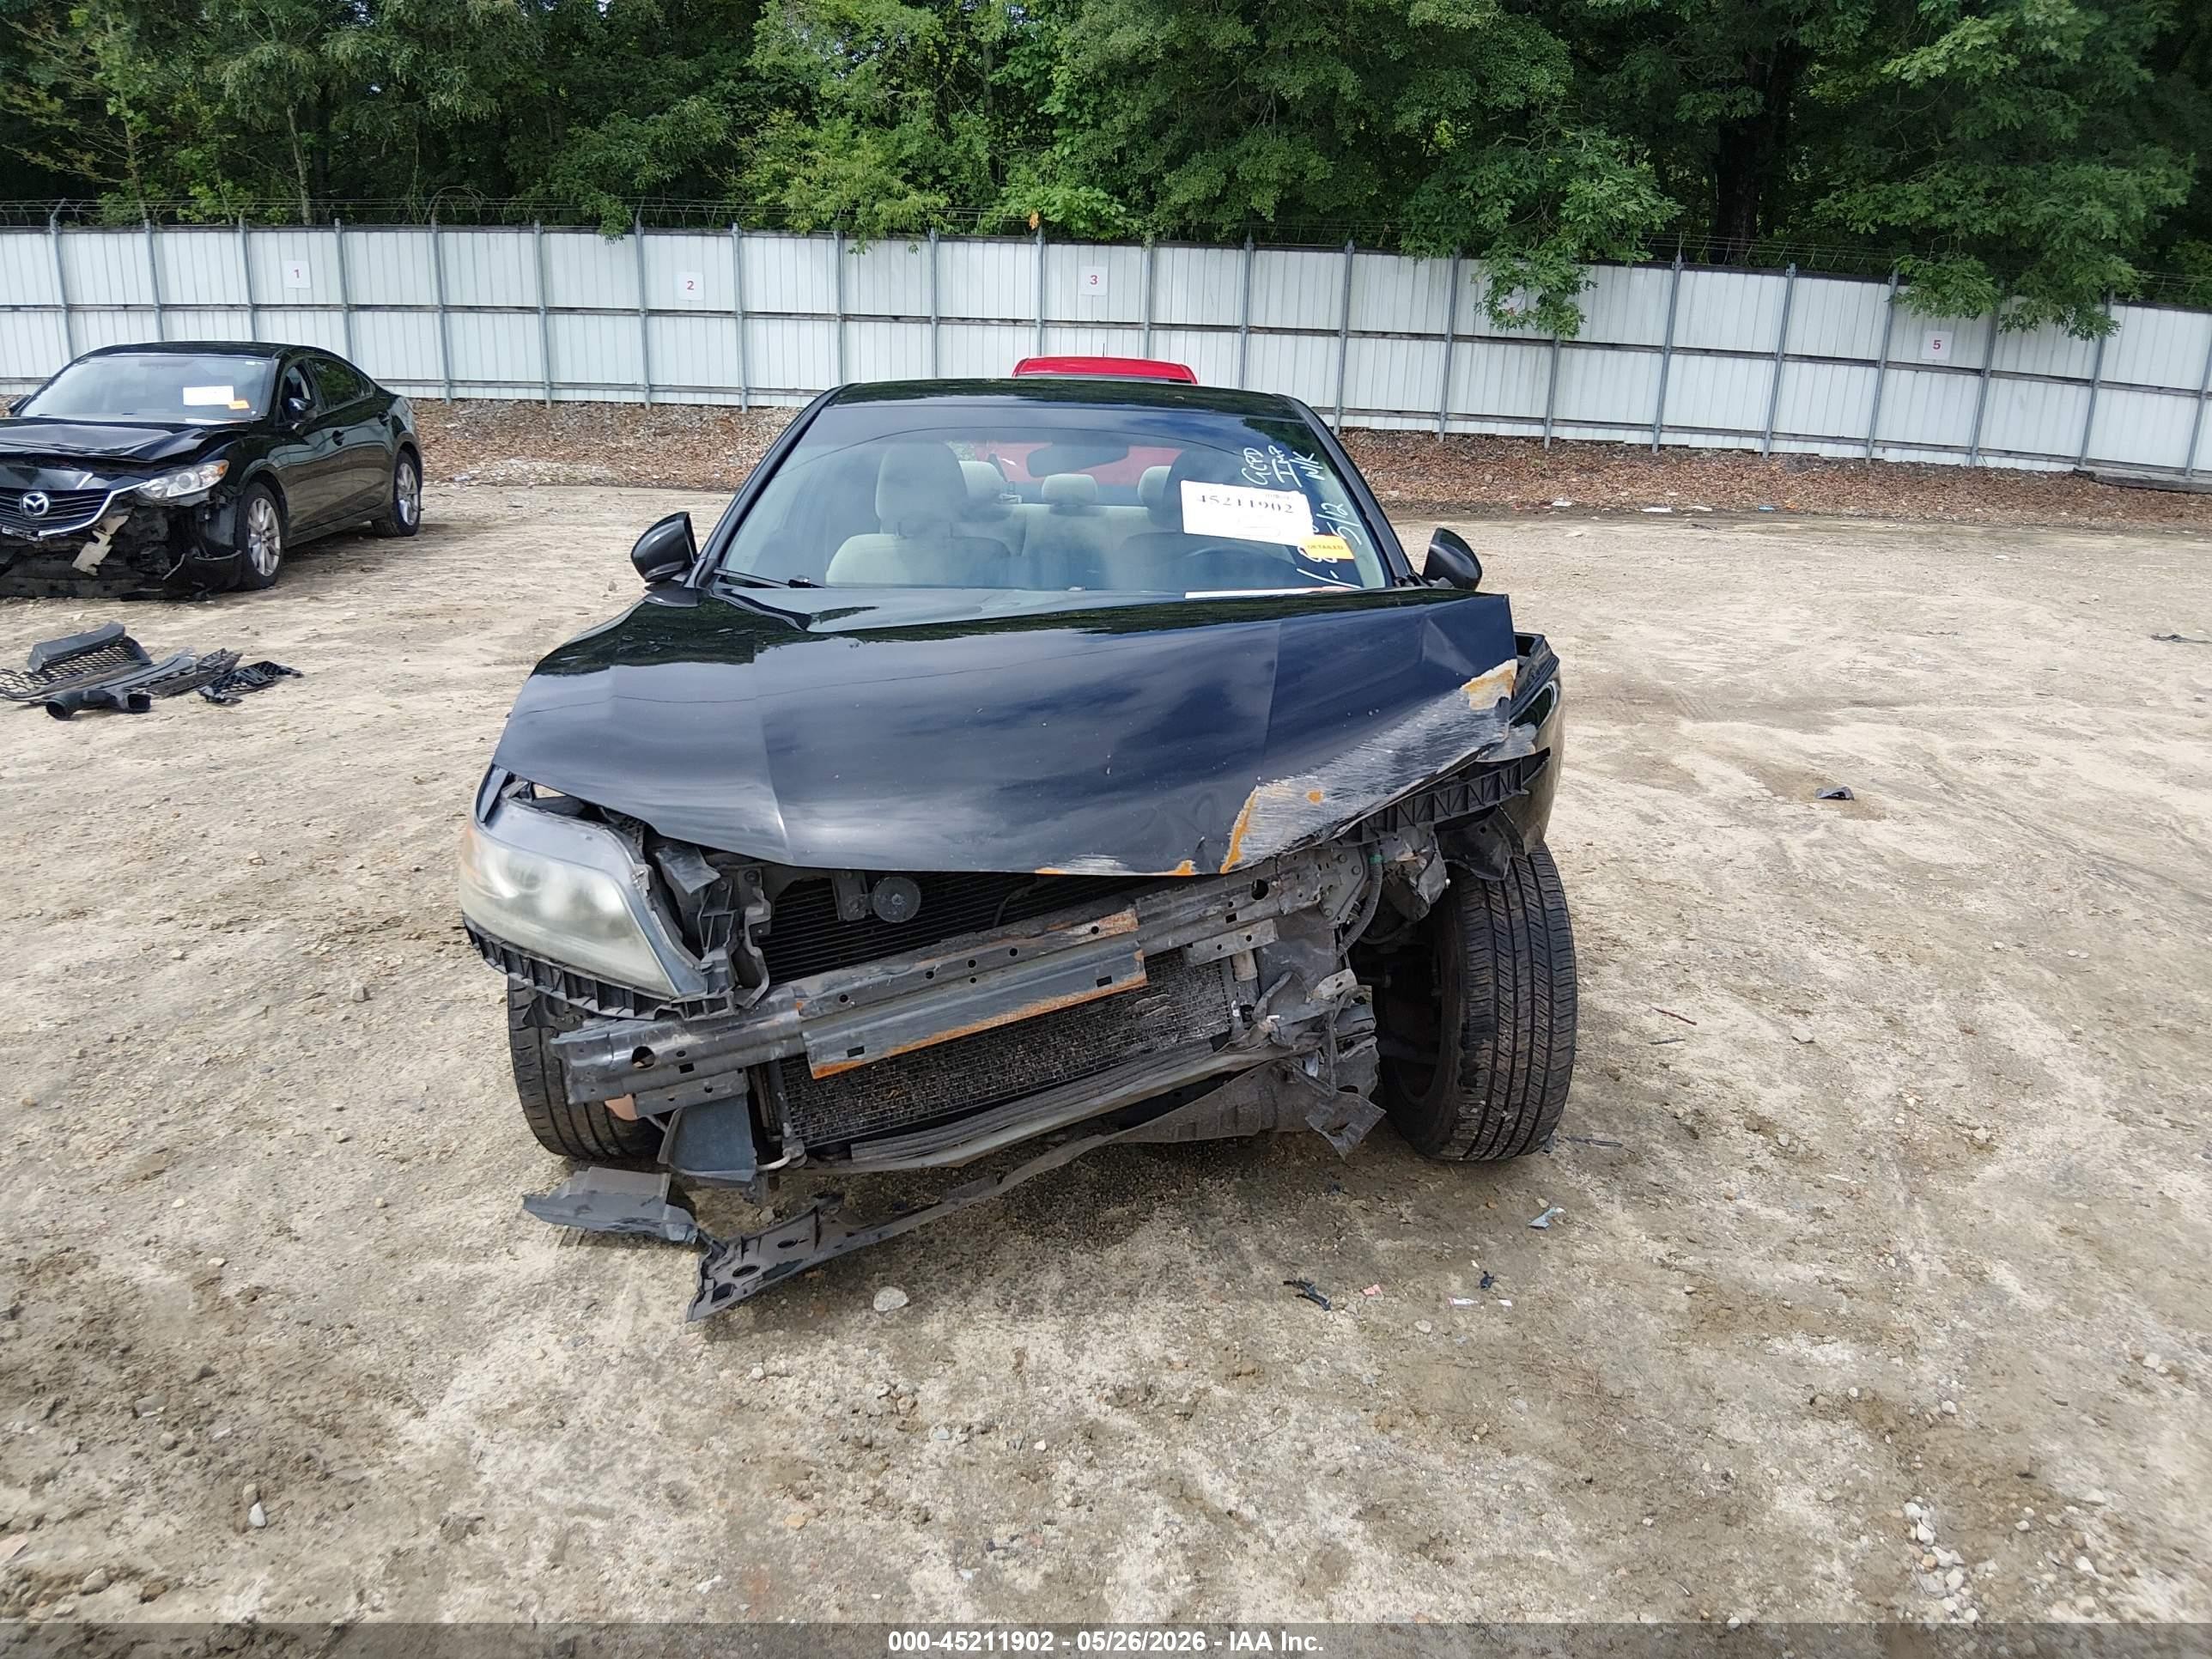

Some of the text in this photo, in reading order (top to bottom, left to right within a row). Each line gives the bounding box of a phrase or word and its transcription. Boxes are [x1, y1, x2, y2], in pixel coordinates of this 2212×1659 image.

[294, 269, 301, 279] 1
[1090, 274, 1098, 285] 3
[686, 280, 694, 290] 2
[1932, 339, 1942, 350] 5
[1197, 495, 1295, 514] 45211902
